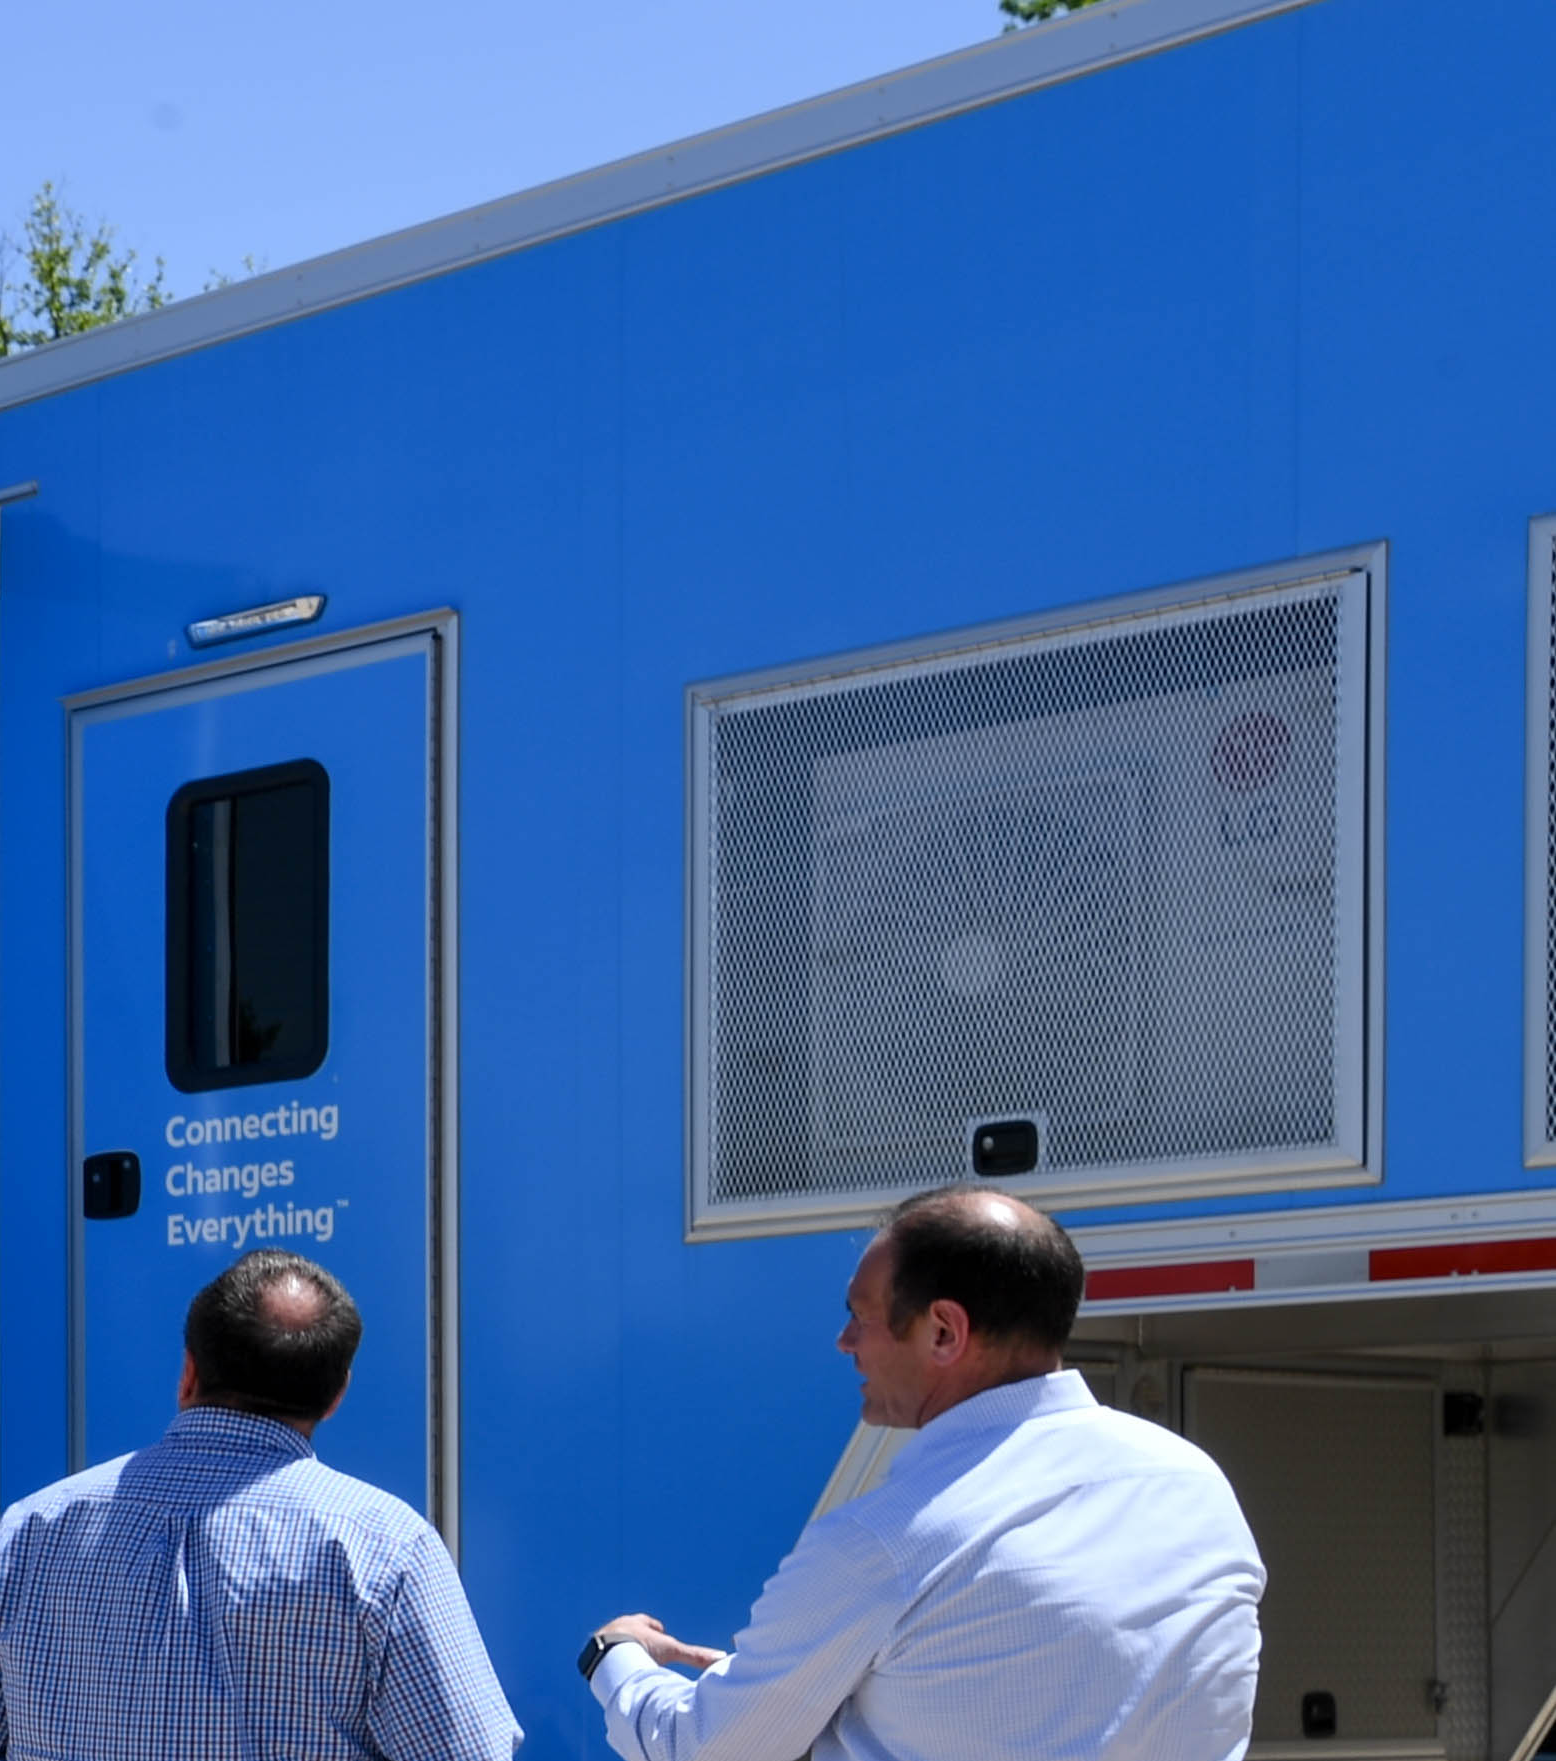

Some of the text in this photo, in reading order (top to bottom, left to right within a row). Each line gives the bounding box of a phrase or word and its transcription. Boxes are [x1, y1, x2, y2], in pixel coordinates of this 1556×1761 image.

[165, 1100, 339, 1148] Connecting
[165, 1159, 295, 1199] Changes
[167, 1201, 335, 1249] Everything
